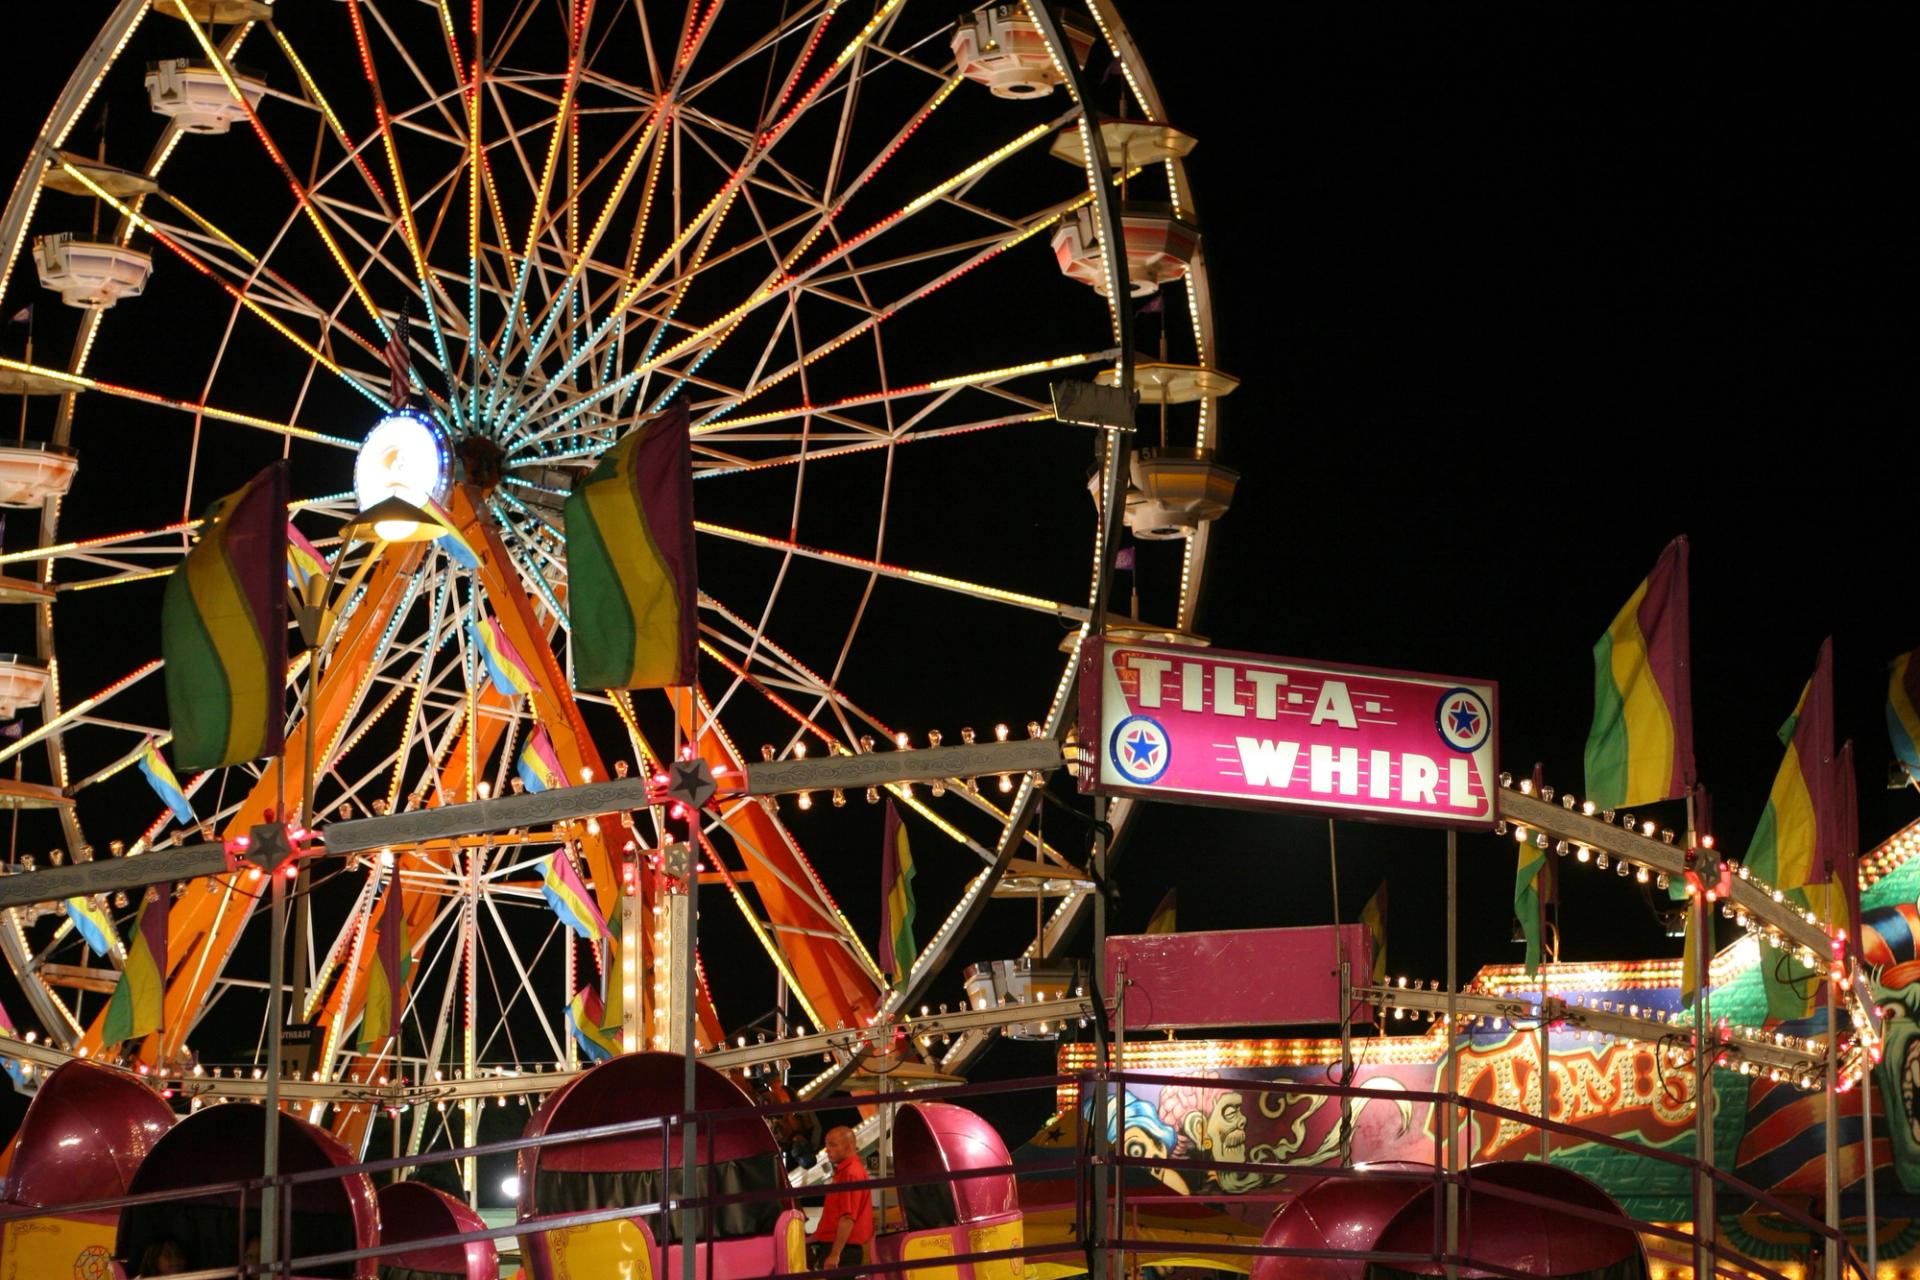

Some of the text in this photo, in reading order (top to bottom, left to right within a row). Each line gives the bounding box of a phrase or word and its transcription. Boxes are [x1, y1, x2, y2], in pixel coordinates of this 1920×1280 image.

[1127, 656, 1380, 729] TILT-A-
[1235, 736, 1478, 809] WHIRL
[1455, 1040, 1700, 1157] TOMBS
